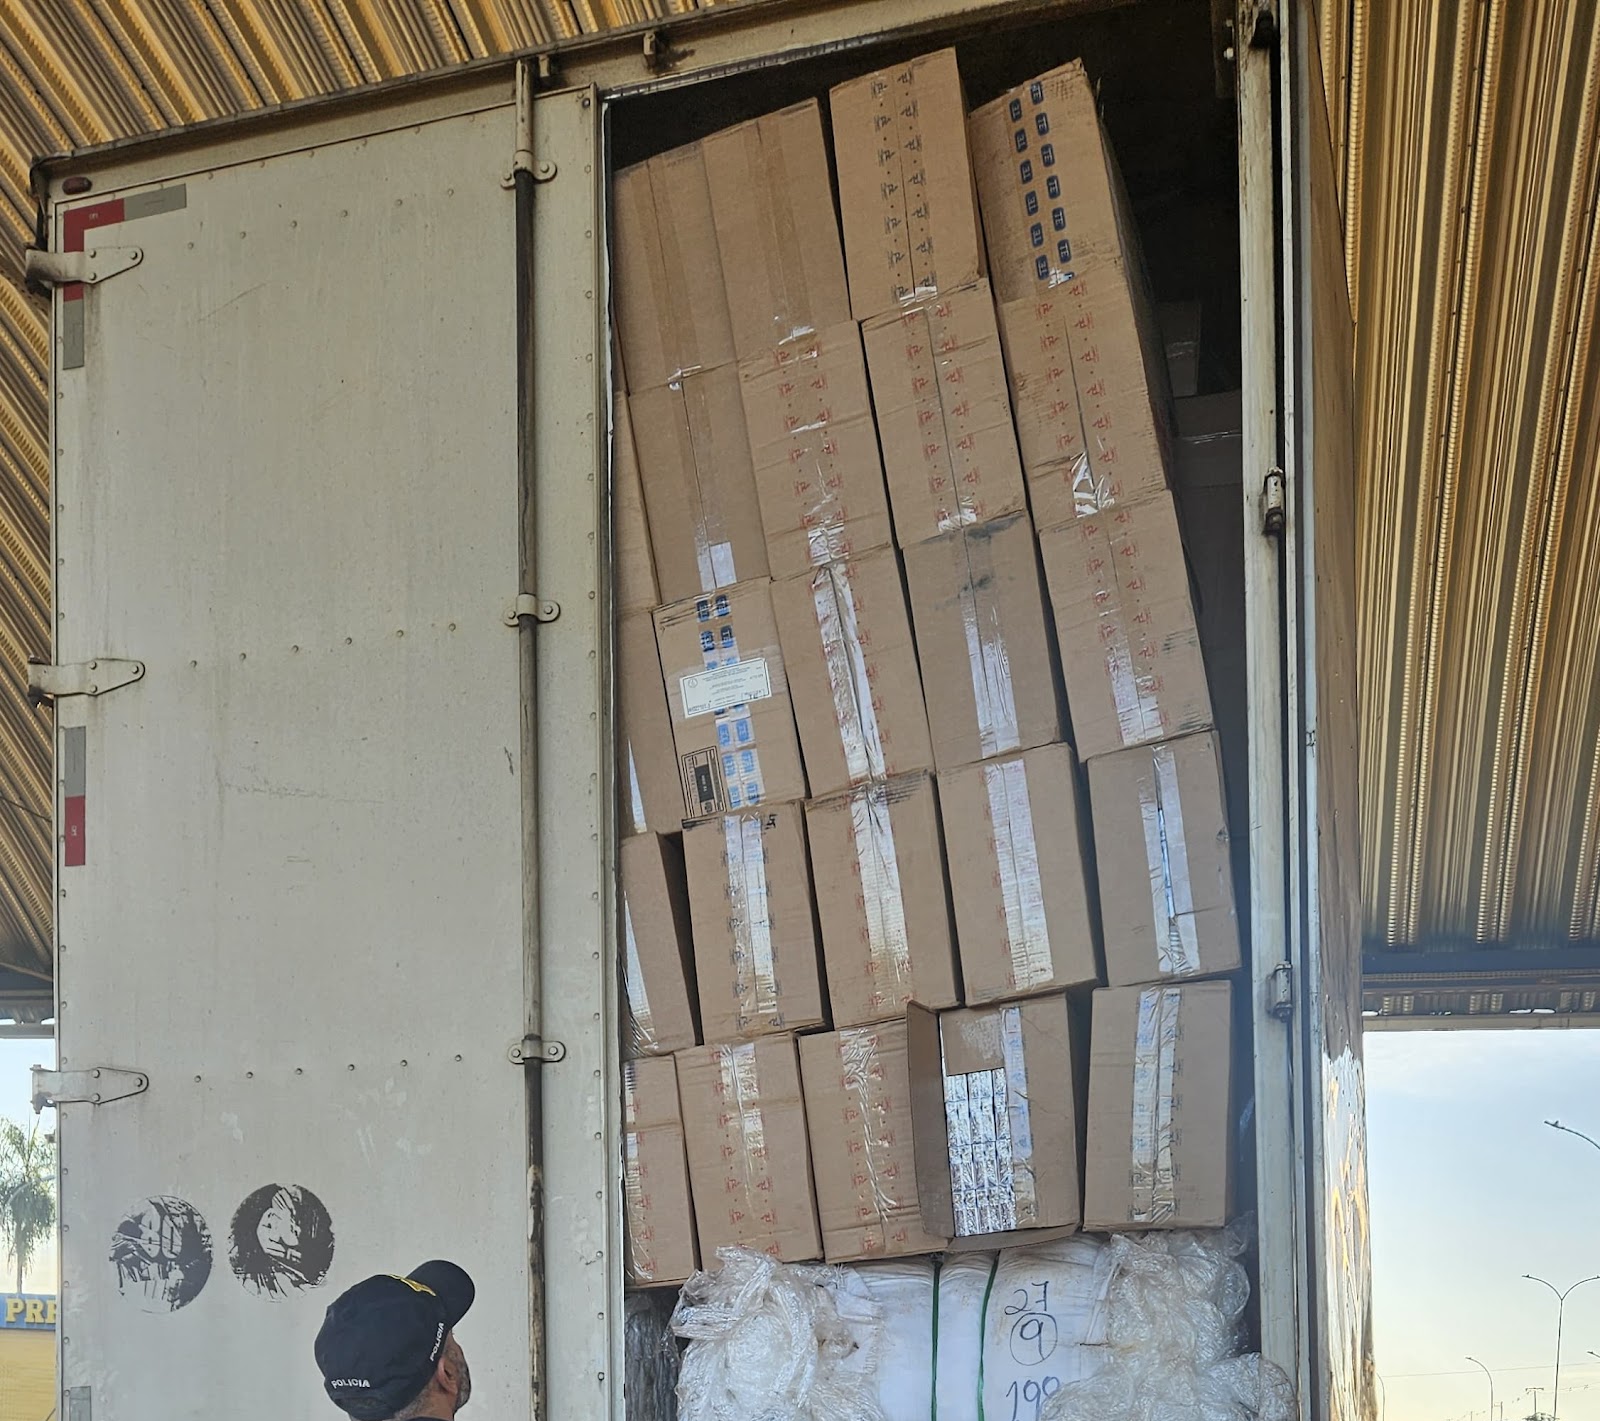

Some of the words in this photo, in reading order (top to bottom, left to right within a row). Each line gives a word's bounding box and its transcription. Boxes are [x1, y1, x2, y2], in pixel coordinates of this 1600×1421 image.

[1004, 1281, 1050, 1316] 27
[429, 1322, 445, 1362] POLICIA
[331, 1377, 371, 1389] POLICIA
